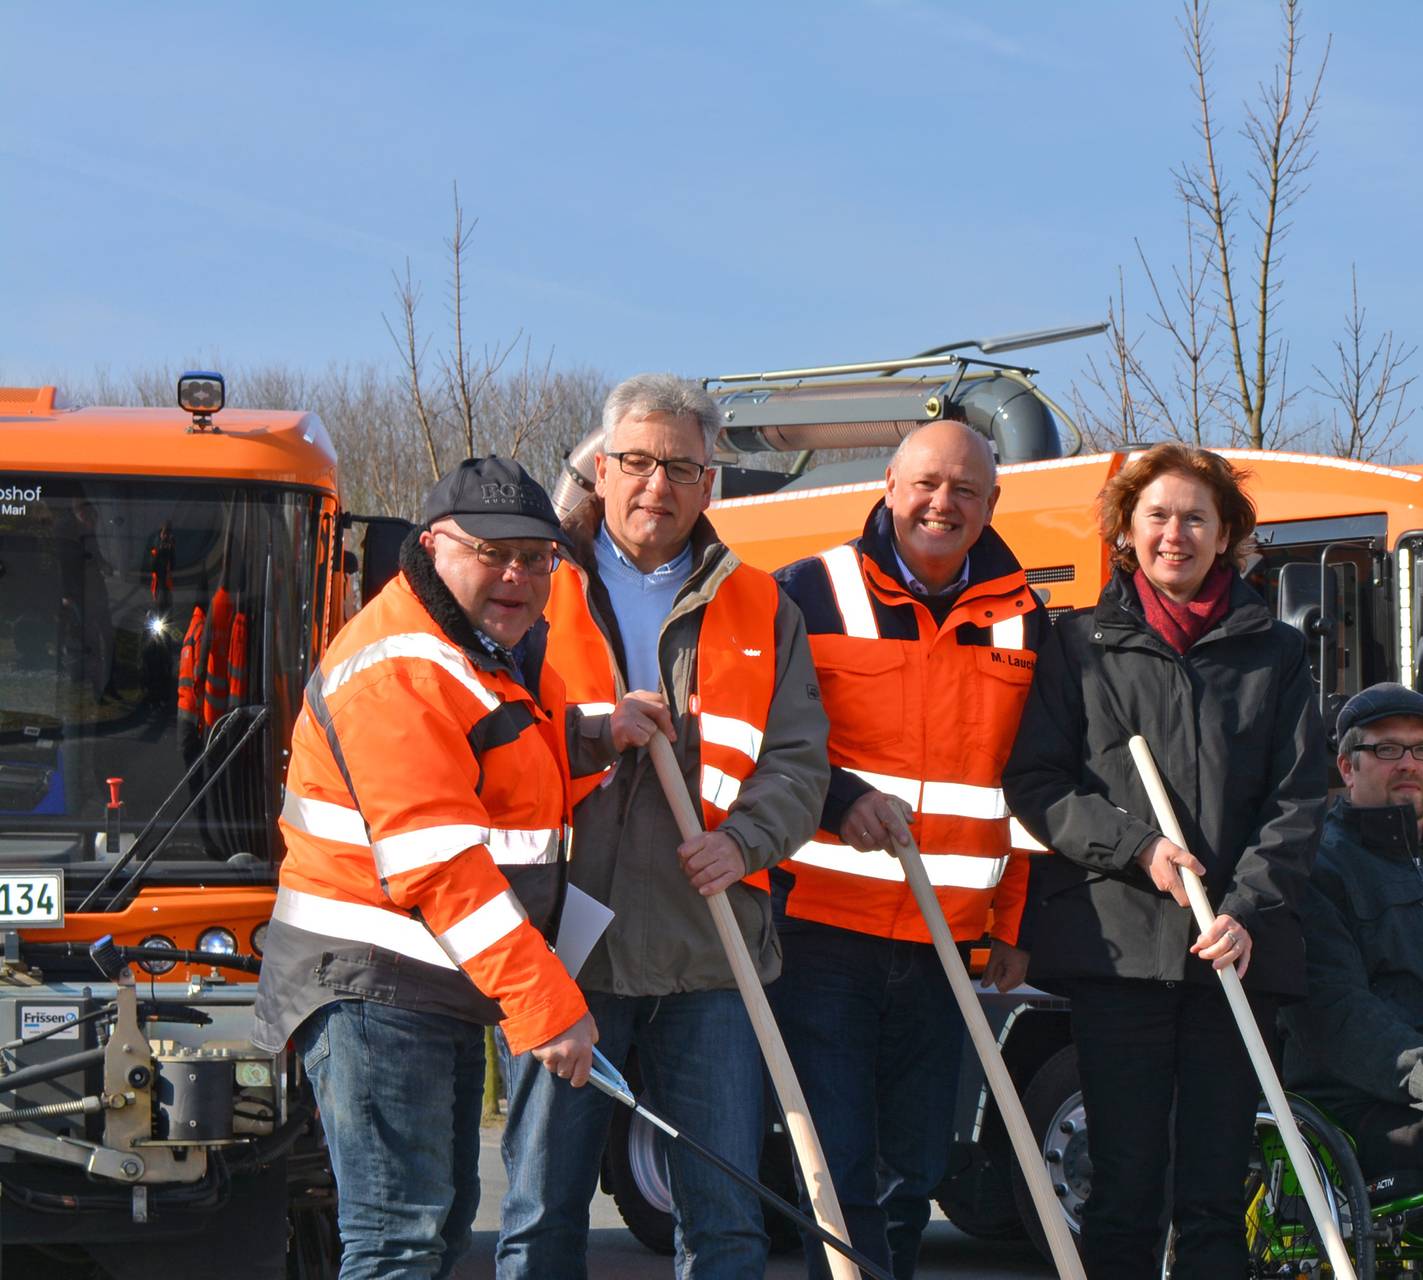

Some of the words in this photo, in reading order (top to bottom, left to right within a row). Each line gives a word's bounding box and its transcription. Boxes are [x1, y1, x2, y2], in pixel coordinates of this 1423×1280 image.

[1, 504, 26, 516] Marl
[991, 652, 1006, 663] M.
[0, 884, 54, 915] 134
[24, 1012, 66, 1023] Frissen
